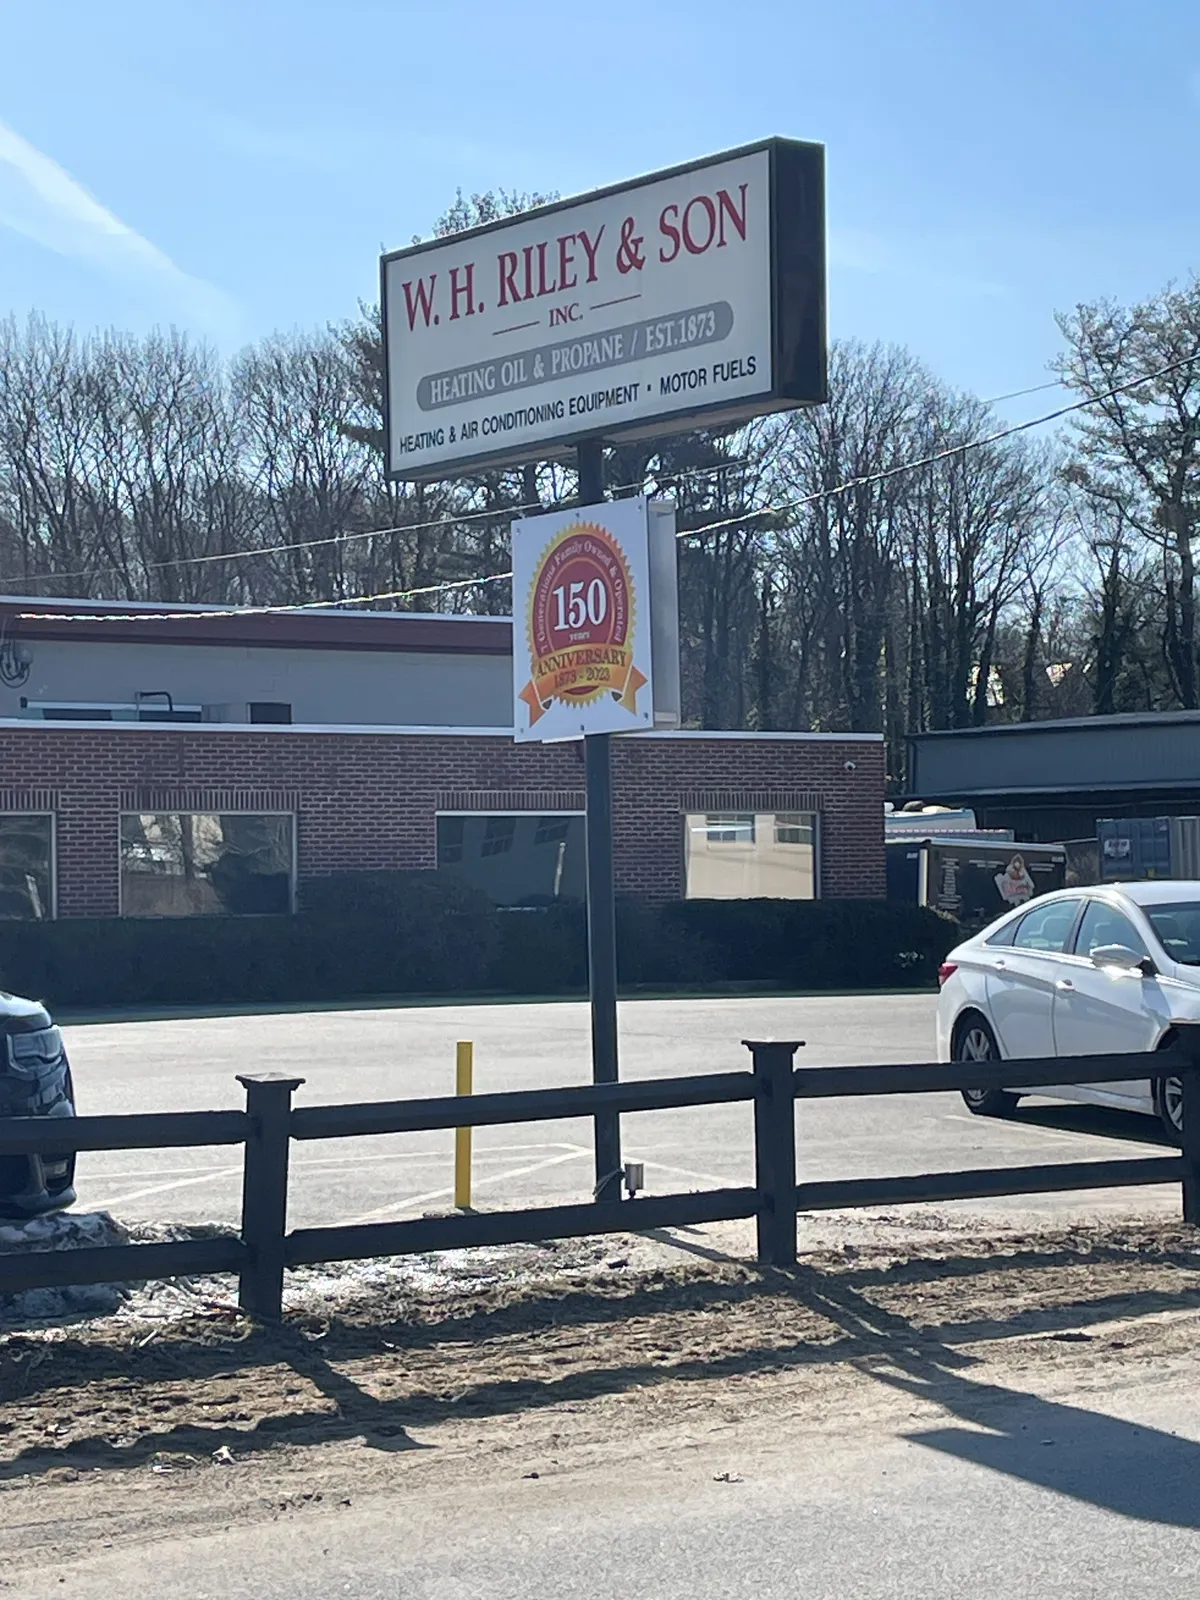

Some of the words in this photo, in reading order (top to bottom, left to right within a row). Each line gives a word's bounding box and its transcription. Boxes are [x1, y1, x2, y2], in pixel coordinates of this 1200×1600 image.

[401, 274, 439, 332] W.
[449, 263, 485, 320] H.
[496, 224, 606, 307] RILEY
[616, 216, 646, 274] &
[658, 183, 749, 263] SON
[548, 303, 584, 327] INC.
[430, 366, 496, 404] HEATING
[501, 360, 527, 387] OIL
[533, 358, 544, 378] &
[551, 335, 623, 375] PROPANE
[629, 330, 638, 356] /
[645, 311, 717, 353] EST.1873
[399, 427, 445, 455] HEATING
[449, 426, 457, 442] &
[460, 418, 479, 439] AIR
[481, 398, 565, 435] CONDITIONING
[568, 383, 641, 416] EQUIPMENT
[660, 368, 707, 395] MOTOR
[713, 355, 757, 384] FUELS
[552, 578, 607, 631] 150
[568, 632, 590, 643] years
[535, 649, 627, 678] ANNIVERSARY
[586, 666, 611, 682] 2023
